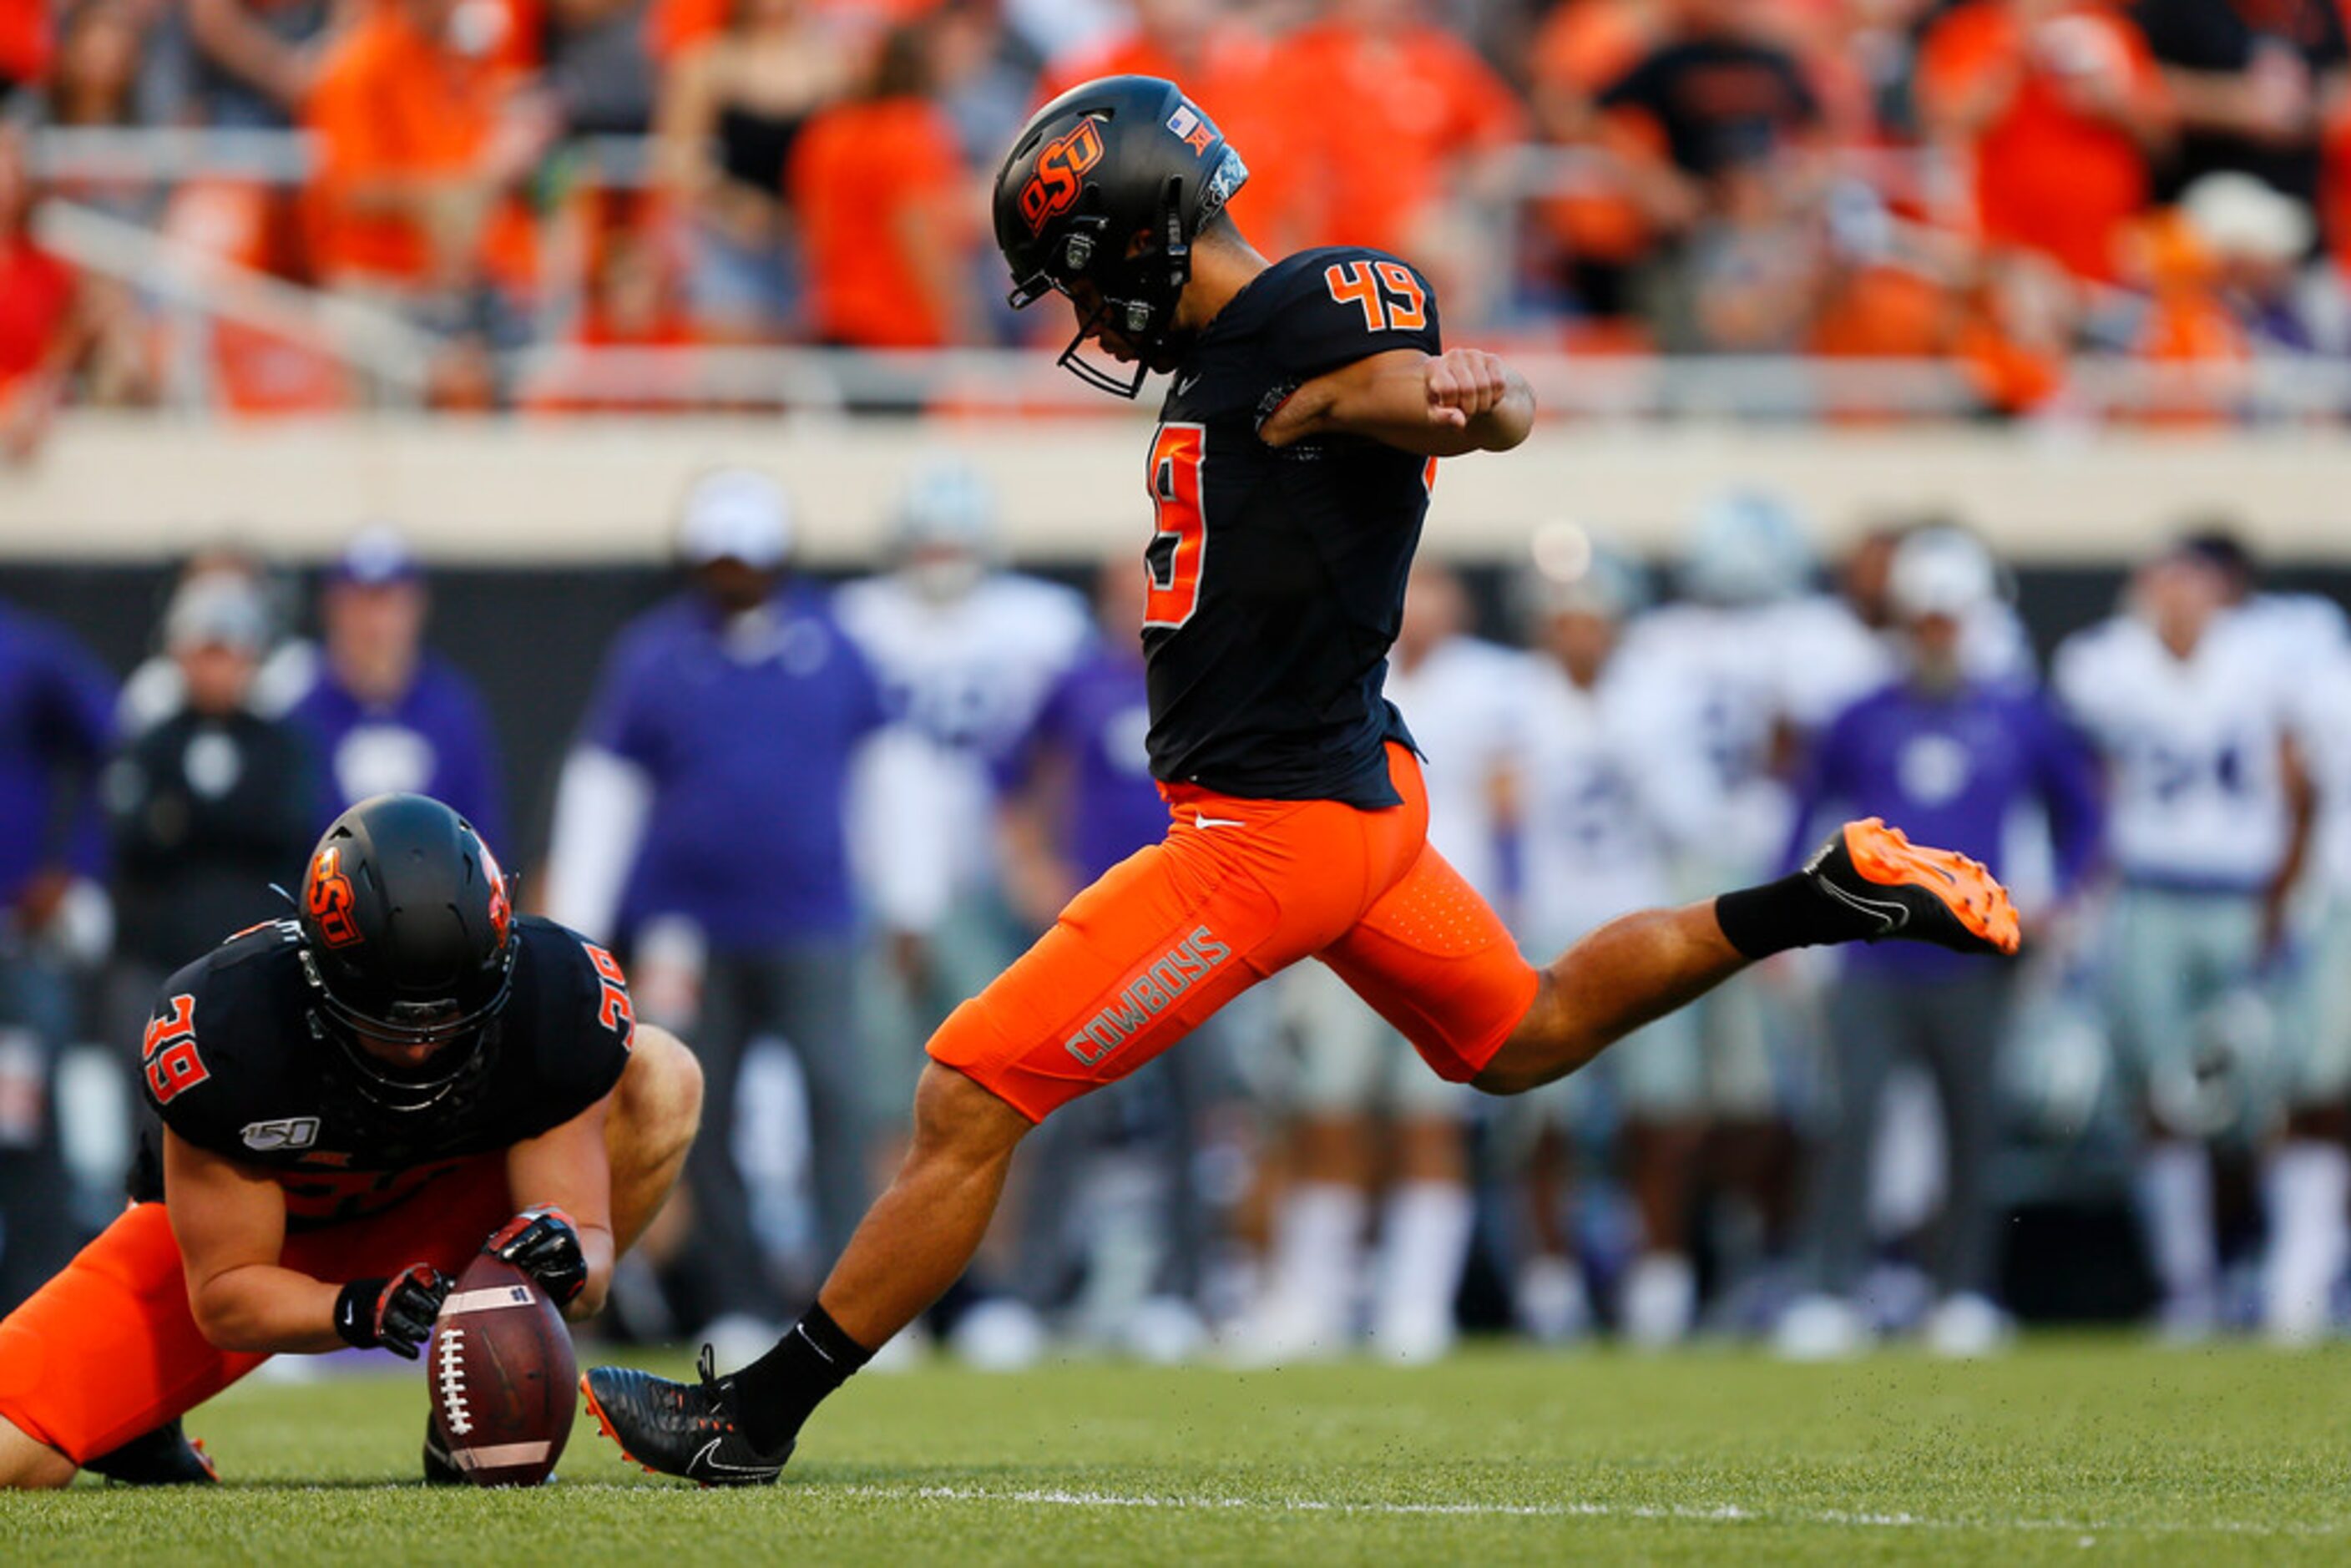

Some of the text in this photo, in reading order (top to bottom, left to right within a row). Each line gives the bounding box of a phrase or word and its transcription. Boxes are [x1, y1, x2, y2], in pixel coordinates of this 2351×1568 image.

[1019, 117, 1104, 236] OSU
[1324, 260, 1427, 332] 49
[309, 846, 366, 948] OSU
[143, 994, 211, 1105] 39
[1064, 924, 1231, 1067] COWBOYS
